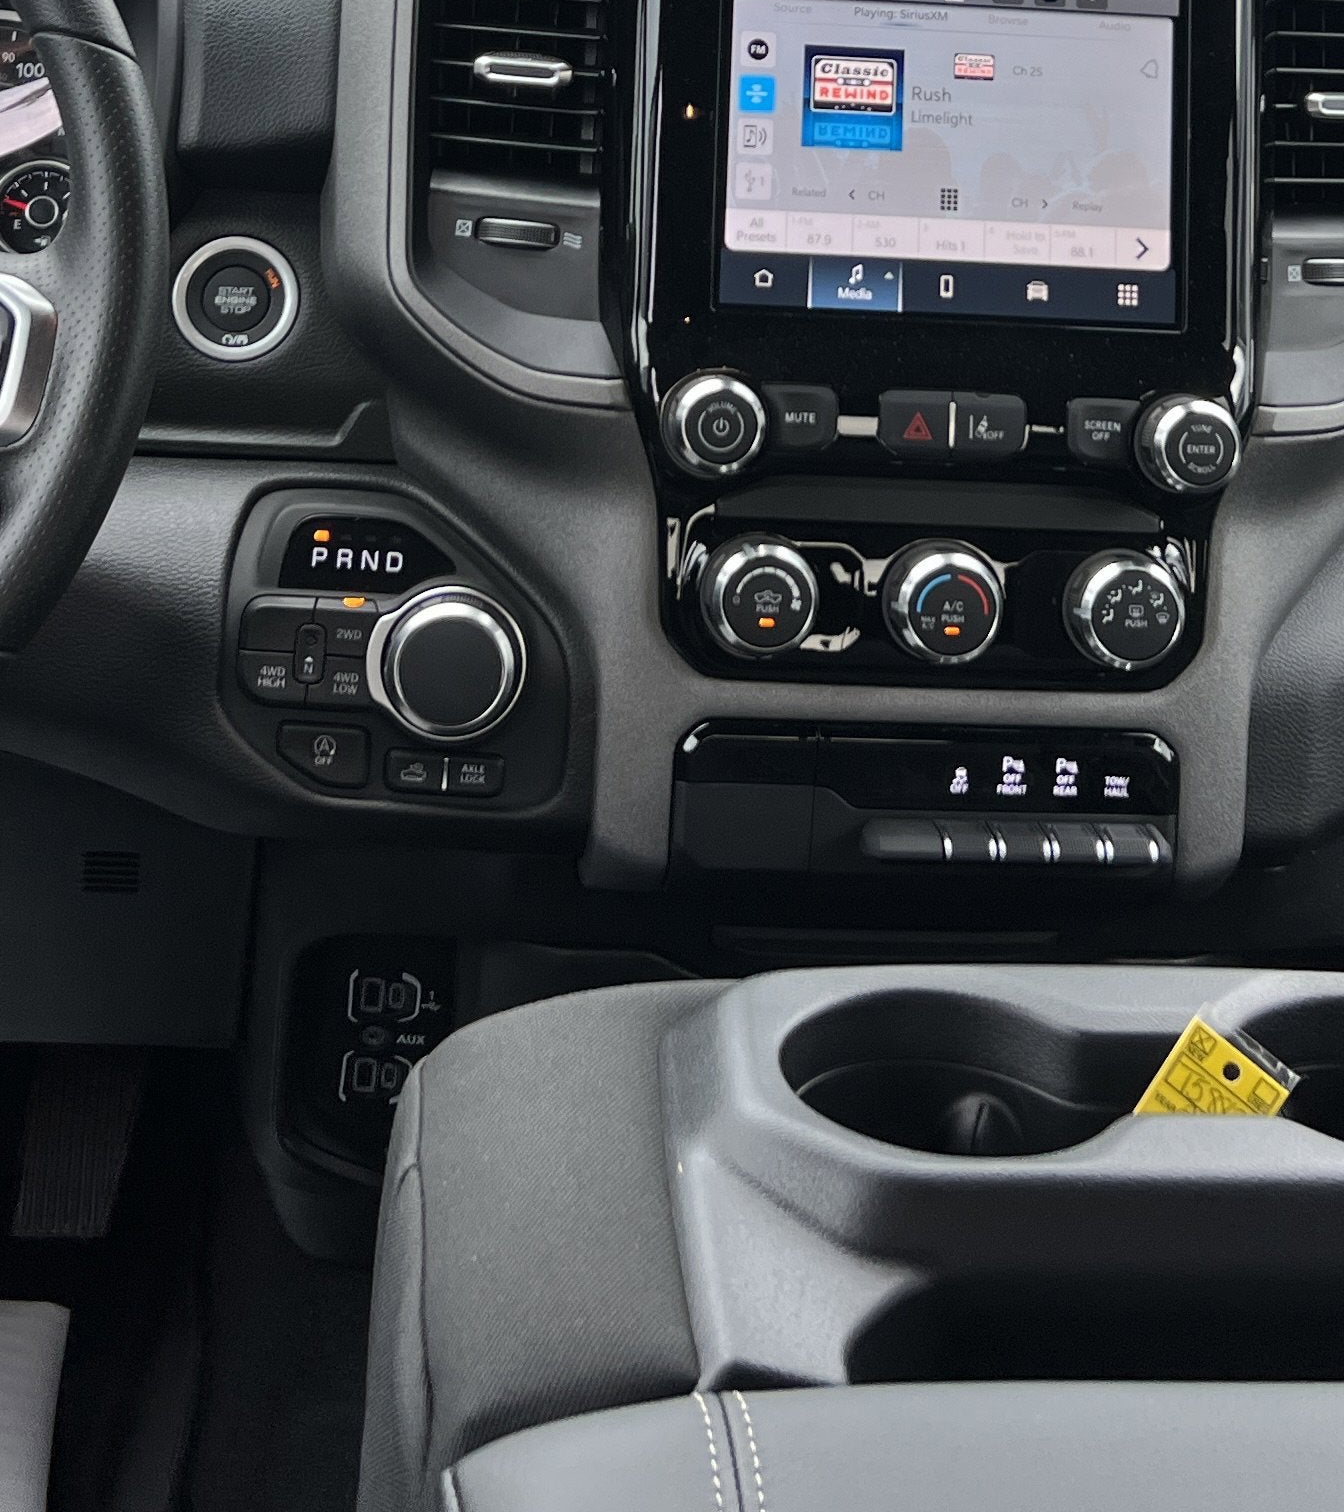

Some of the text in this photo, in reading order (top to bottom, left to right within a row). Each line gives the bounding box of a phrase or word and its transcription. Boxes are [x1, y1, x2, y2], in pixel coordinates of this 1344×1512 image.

[774, 2, 813, 15] Source
[854, 6, 948, 22] Playing: SiriusXM
[988, 14, 1030, 27] Browse
[1099, 21, 1132, 32] Audio
[749, 44, 766, 55] FM
[1, 52, 16, 63] 90
[16, 62, 45, 78] 100
[820, 62, 890, 79] Classic
[1012, 66, 1043, 78] Ch 25
[820, 87, 890, 102] REWIND
[911, 87, 952, 103] Rush
[911, 111, 973, 128] Limelight
[791, 187, 827, 199] Related
[868, 190, 885, 201] CH
[1011, 197, 1029, 209] CH
[1072, 200, 1103, 213] Replay
[13, 219, 22, 230] E
[875, 237, 896, 249] 530
[218, 286, 254, 296] START
[837, 287, 873, 301] Media
[214, 296, 257, 306] ENGINE
[706, 400, 737, 415] VOLUME
[784, 411, 816, 425] MUTE
[1084, 419, 1121, 432] SCREEN
[1091, 431, 1110, 443] OFF
[1186, 444, 1216, 456] ENTER
[756, 604, 780, 614] PUSH
[943, 600, 964, 612] A/C
[941, 614, 965, 624] PUSH
[1124, 618, 1148, 629] PUSH
[336, 628, 362, 640] 2WD
[260, 666, 286, 677] 4WD
[304, 663, 313, 675] N
[257, 677, 286, 689] HIGH
[333, 672, 359, 683] 4WD
[333, 683, 359, 695] LOW
[314, 755, 333, 766] OFF
[461, 763, 486, 774] AXLE
[1002, 773, 1022, 784] OFF
[1056, 774, 1076, 785] OFF
[396, 1034, 425, 1045] AUX
